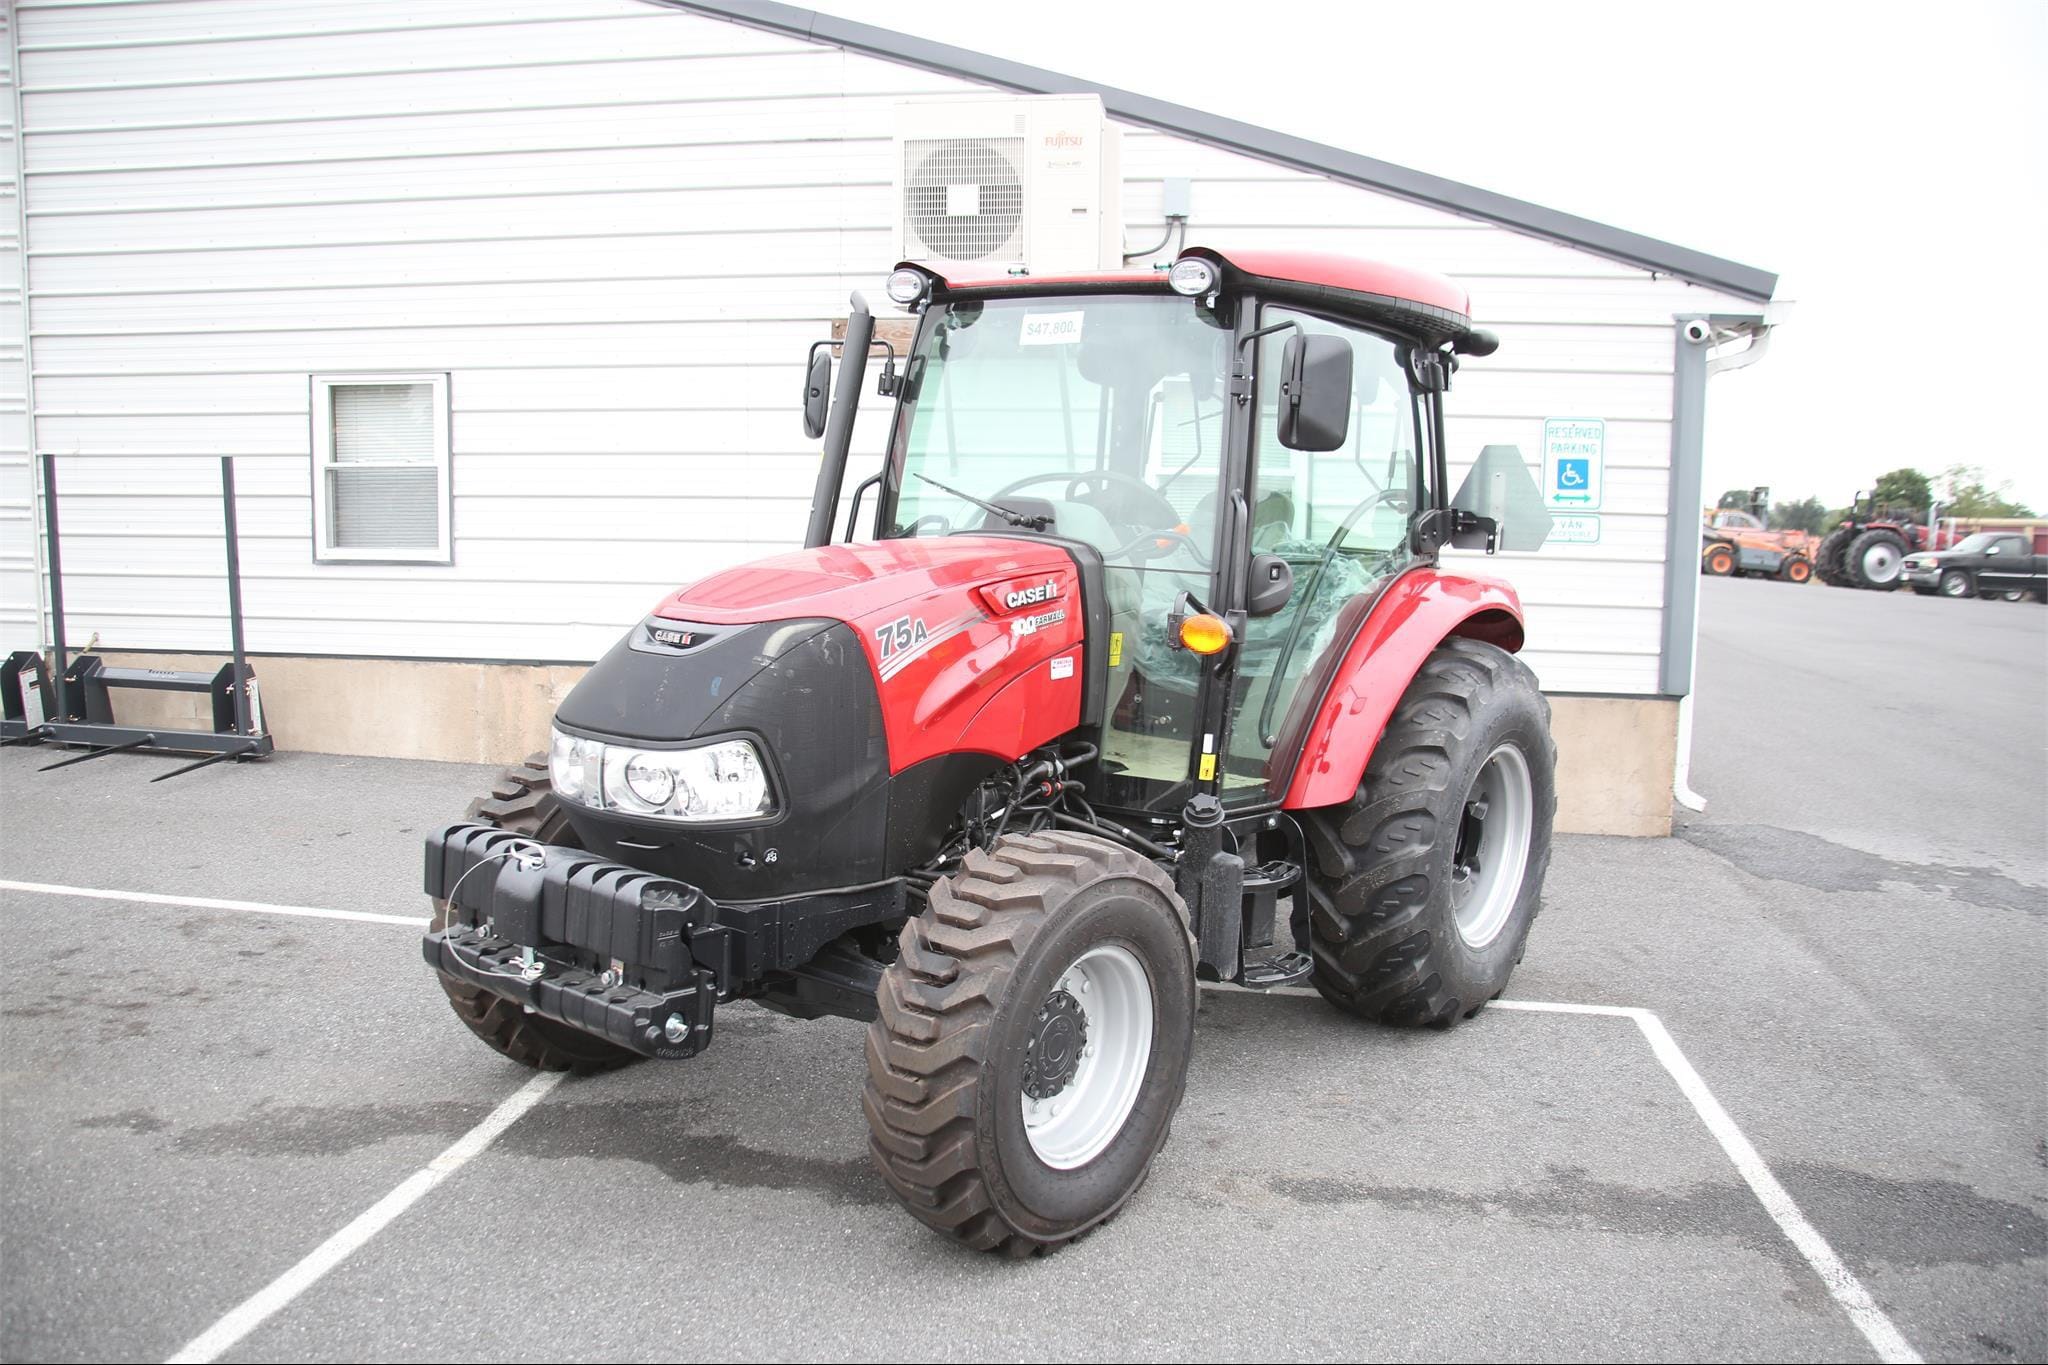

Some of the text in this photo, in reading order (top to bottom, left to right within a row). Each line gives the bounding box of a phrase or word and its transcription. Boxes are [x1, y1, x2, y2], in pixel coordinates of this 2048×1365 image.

[1045, 132, 1083, 148] FUJITSU
[1548, 426, 1601, 439] RESERVED
[1550, 442, 1597, 454] PARKING
[1560, 520, 1582, 529] VAN
[1034, 609, 1066, 626] FARMALL
